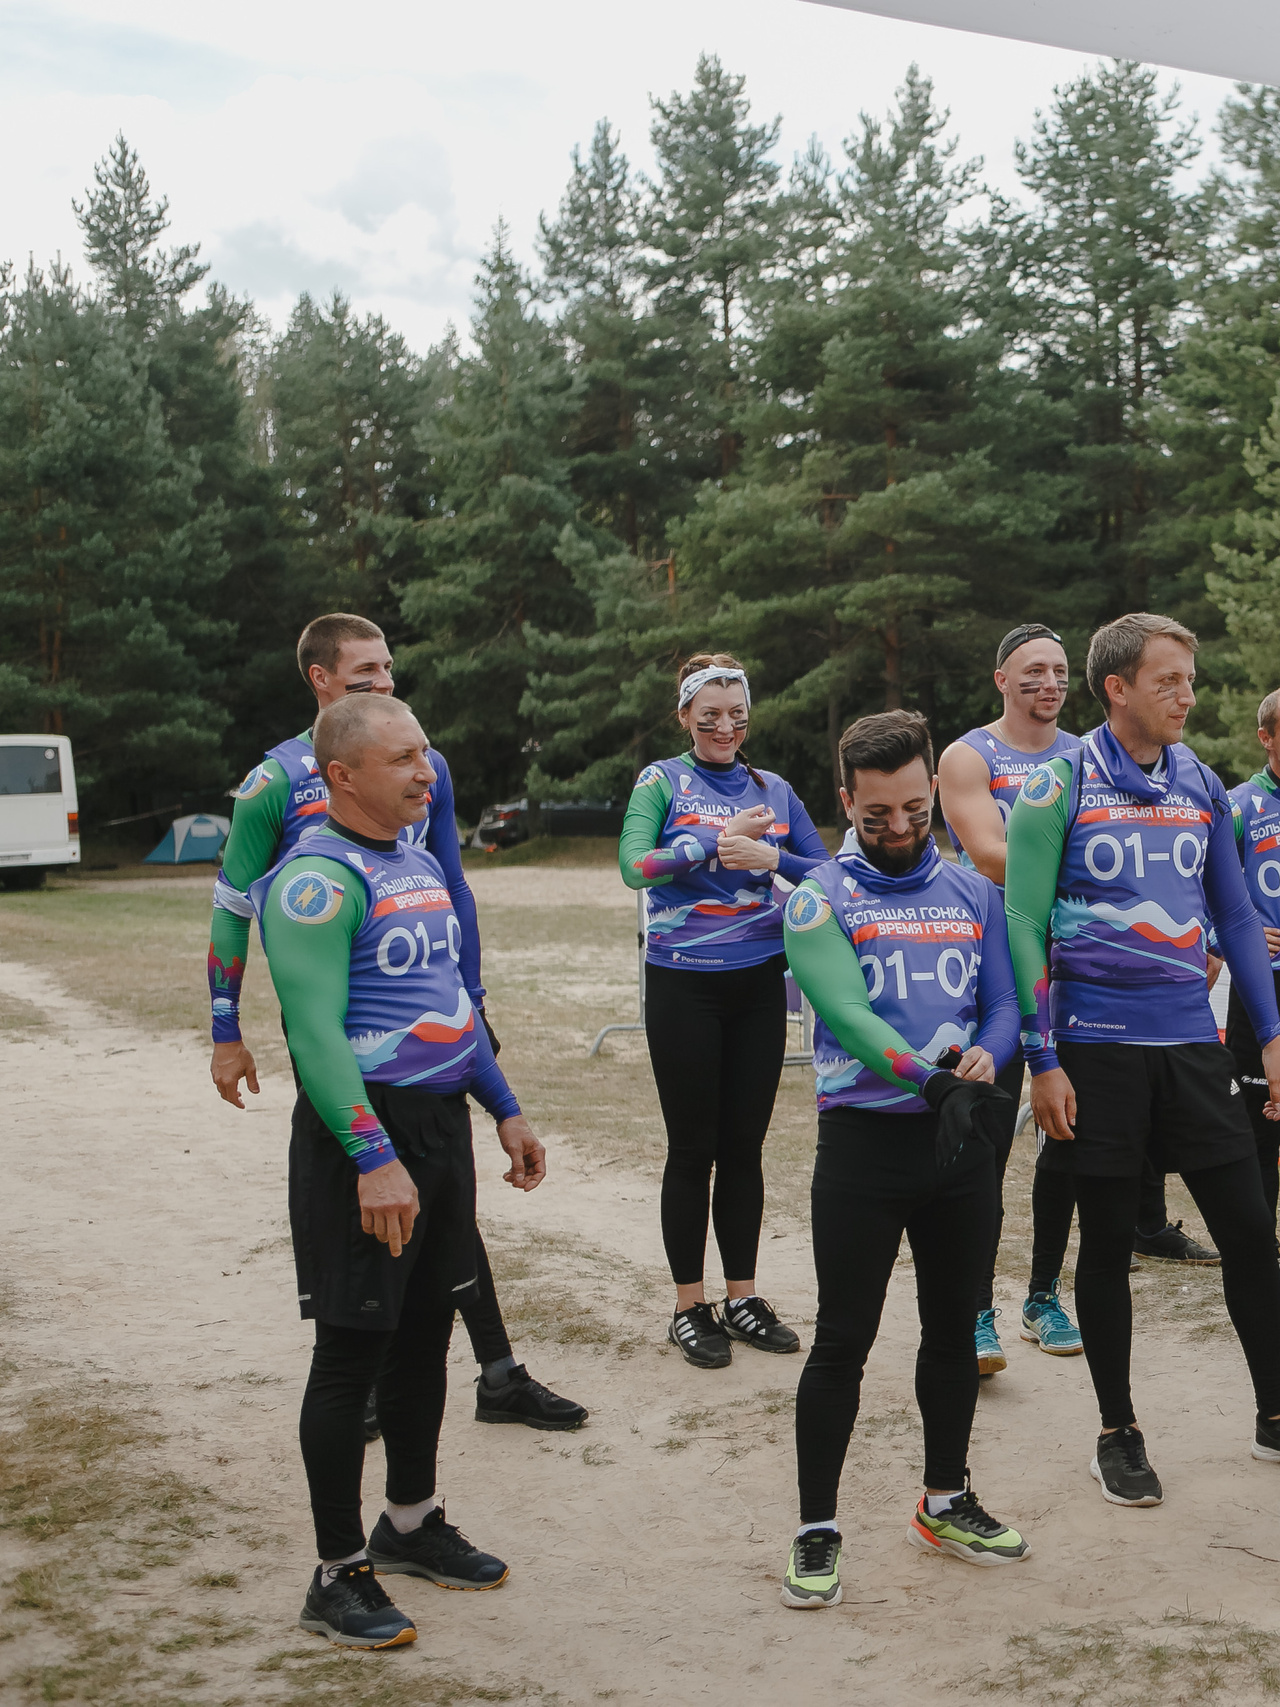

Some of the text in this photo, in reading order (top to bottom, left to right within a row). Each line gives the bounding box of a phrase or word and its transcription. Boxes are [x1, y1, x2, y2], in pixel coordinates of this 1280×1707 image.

[1160, 794, 1195, 808] ОНКА
[675, 802, 732, 816] БОЛЬШАЯ
[1108, 807, 1201, 821] ВРЕМЯ ГЕРОЕВ
[394, 891, 425, 910] ВРЕМЯ
[844, 907, 919, 928] БОЛЬШАЯ
[919, 906, 972, 921] ГОНКА
[877, 922, 974, 936] ВРЕМЯ ГЕРОЕВ
[681, 955, 724, 965] Ростелеком
[1077, 1020, 1126, 1031] Ростелеком
